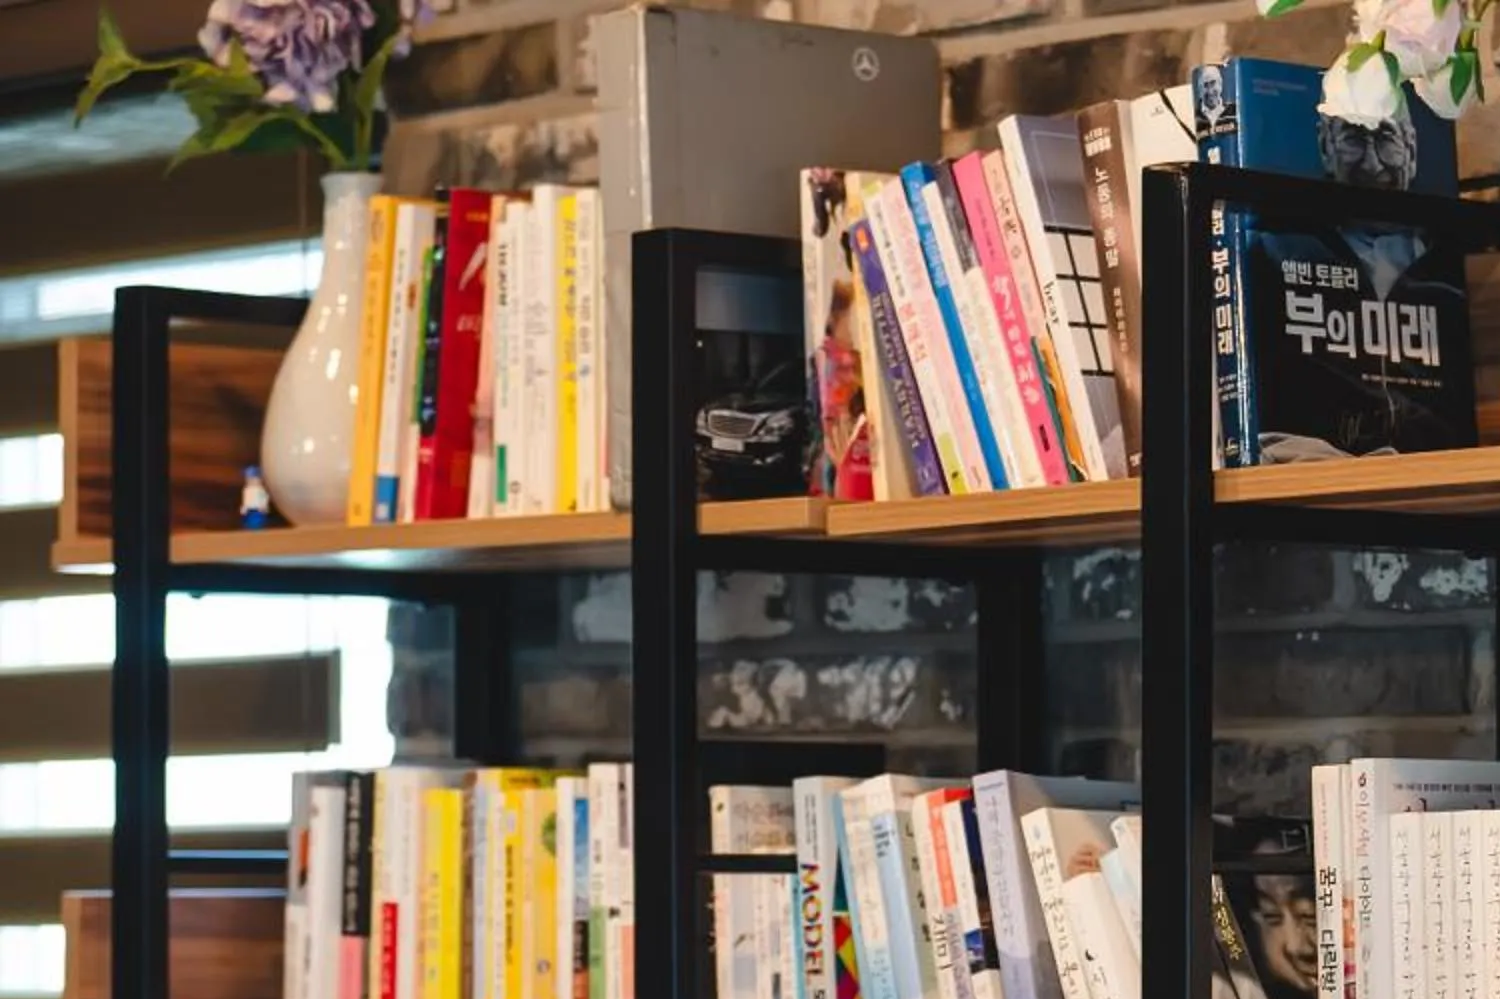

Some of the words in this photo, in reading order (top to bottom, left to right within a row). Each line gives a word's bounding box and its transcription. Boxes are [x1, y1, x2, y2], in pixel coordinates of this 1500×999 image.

[1102, 226, 1120, 269] 종말
[1211, 247, 1231, 300] 부의
[1315, 263, 1359, 292] 토플러
[1214, 303, 1234, 356] 미래
[1284, 289, 1357, 359] 부의
[1360, 299, 1441, 367] 미래
[801, 862, 825, 976] MODEL
[932, 913, 952, 971] 개미
[1319, 929, 1339, 993] 다락방
